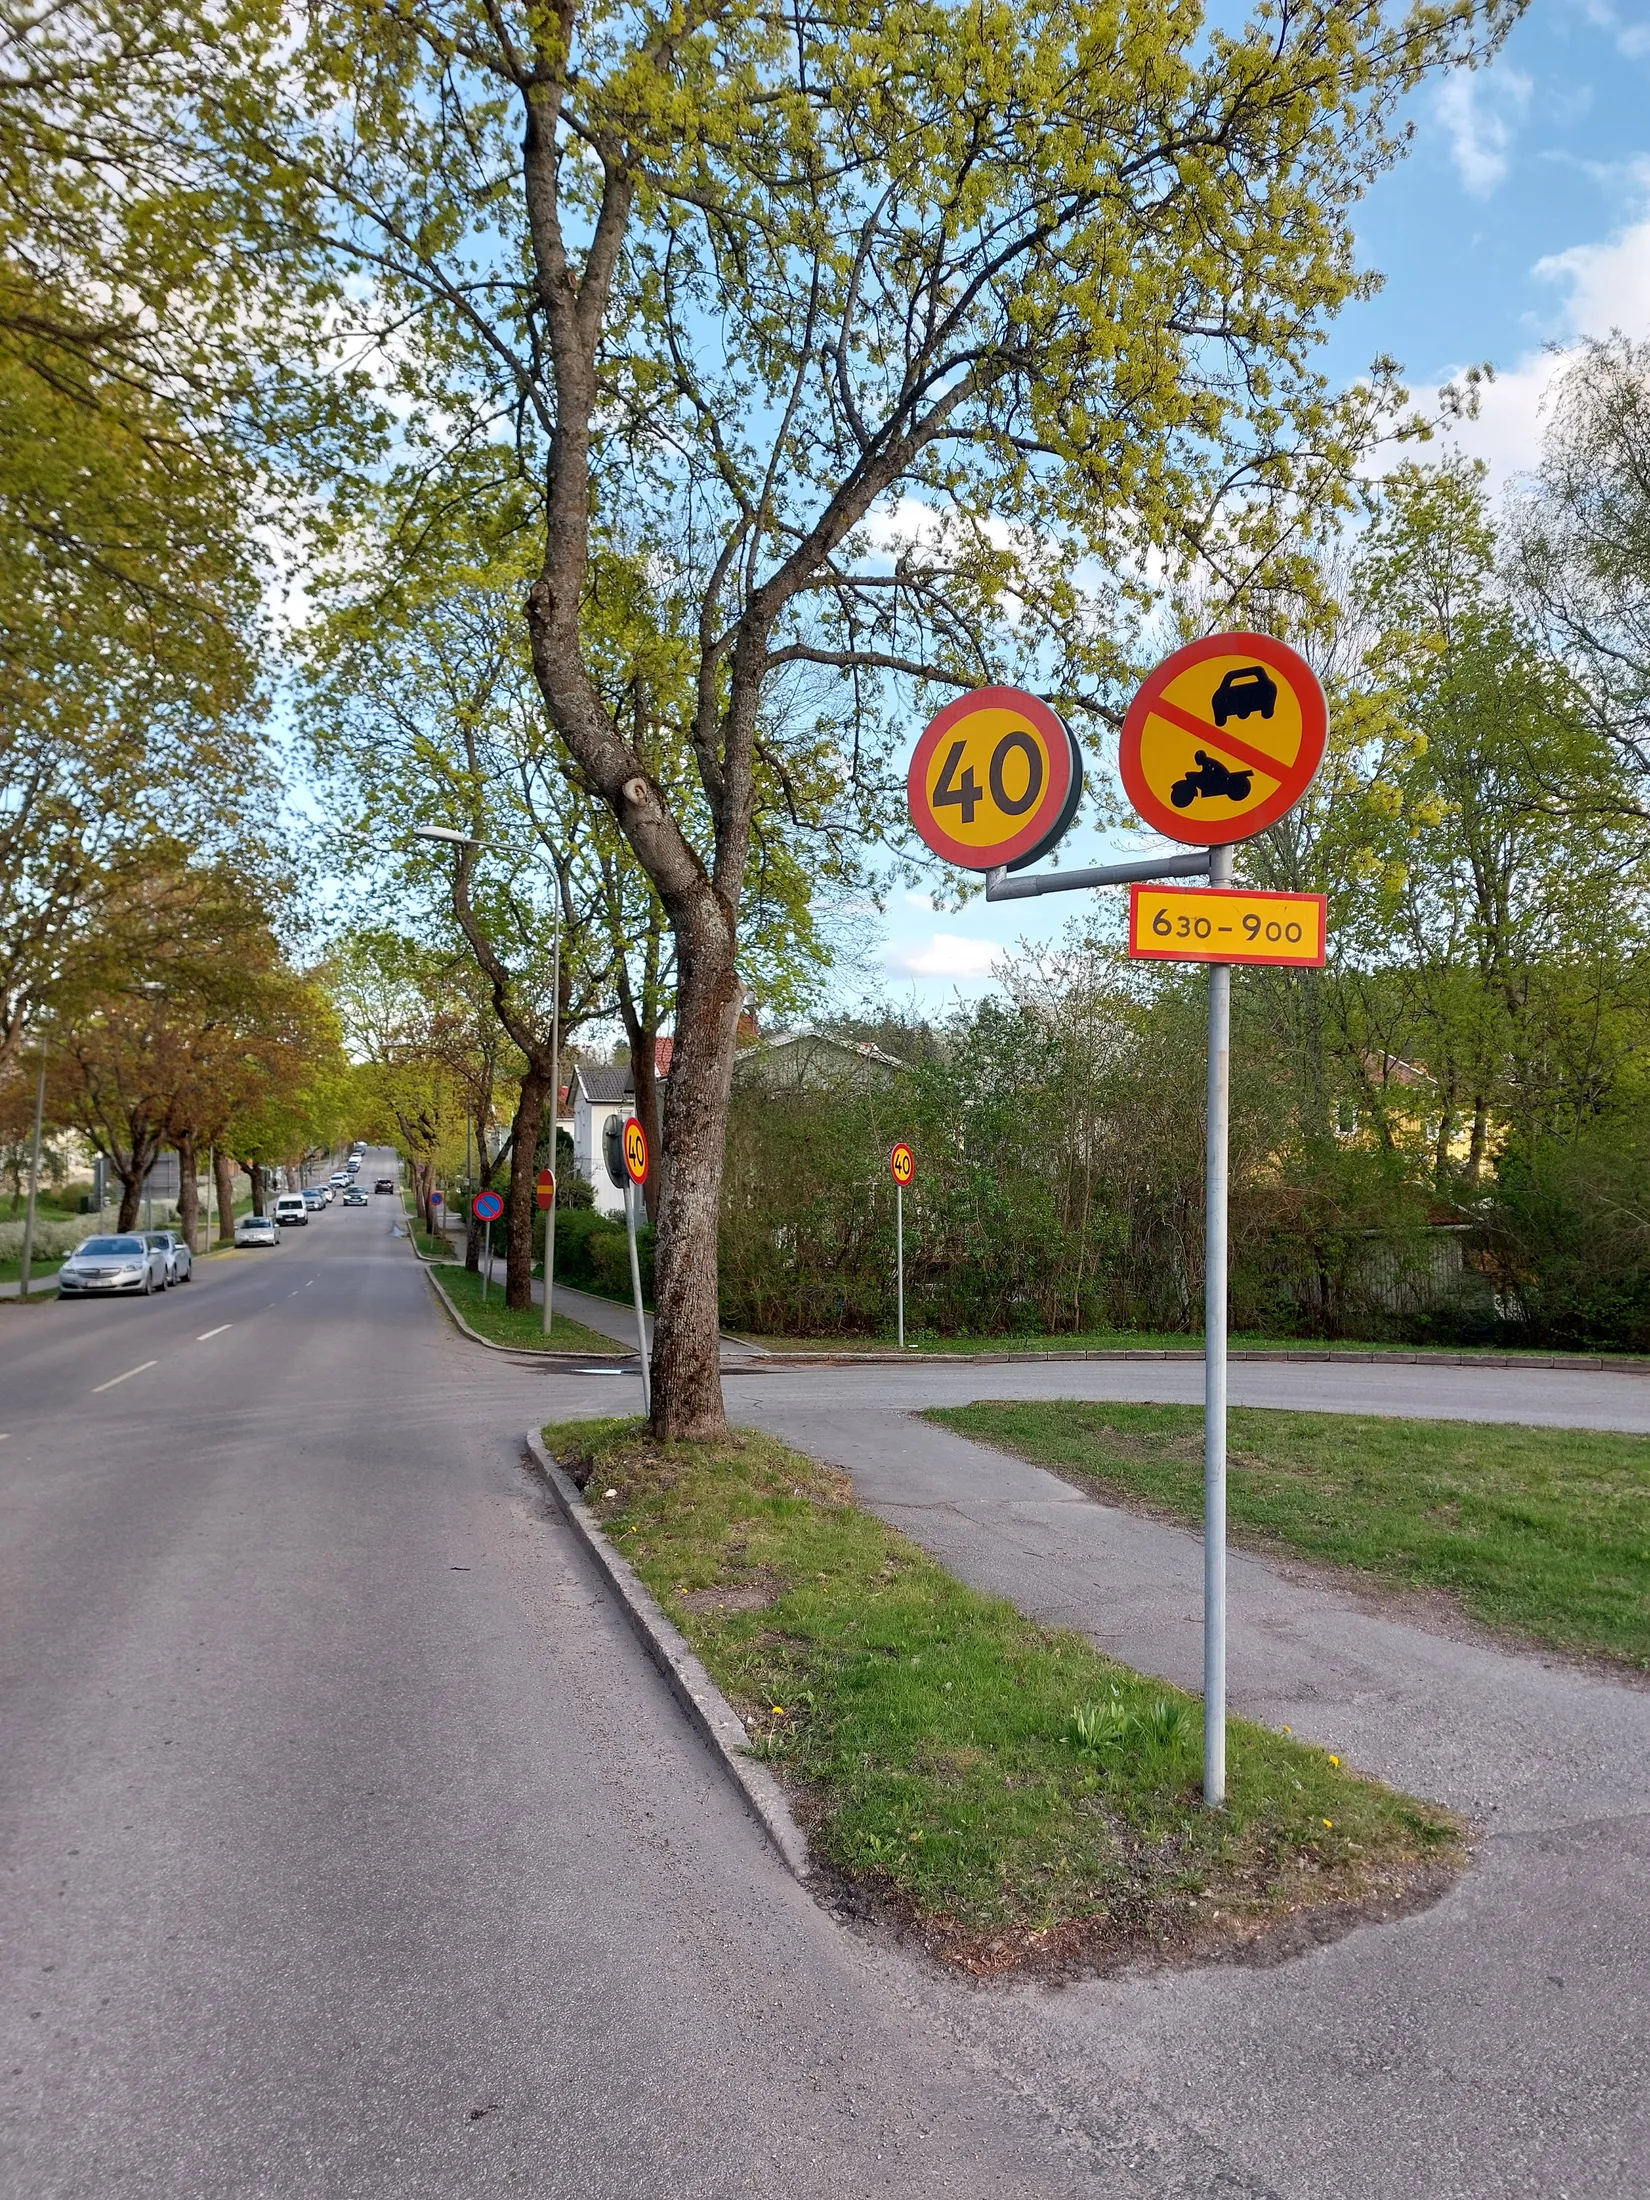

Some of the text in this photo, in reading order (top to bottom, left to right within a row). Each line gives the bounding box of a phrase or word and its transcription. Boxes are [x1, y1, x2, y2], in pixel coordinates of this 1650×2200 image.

[932, 730, 1043, 824] 40
[628, 1135, 645, 1167] 40
[895, 1154, 911, 1175] 40
